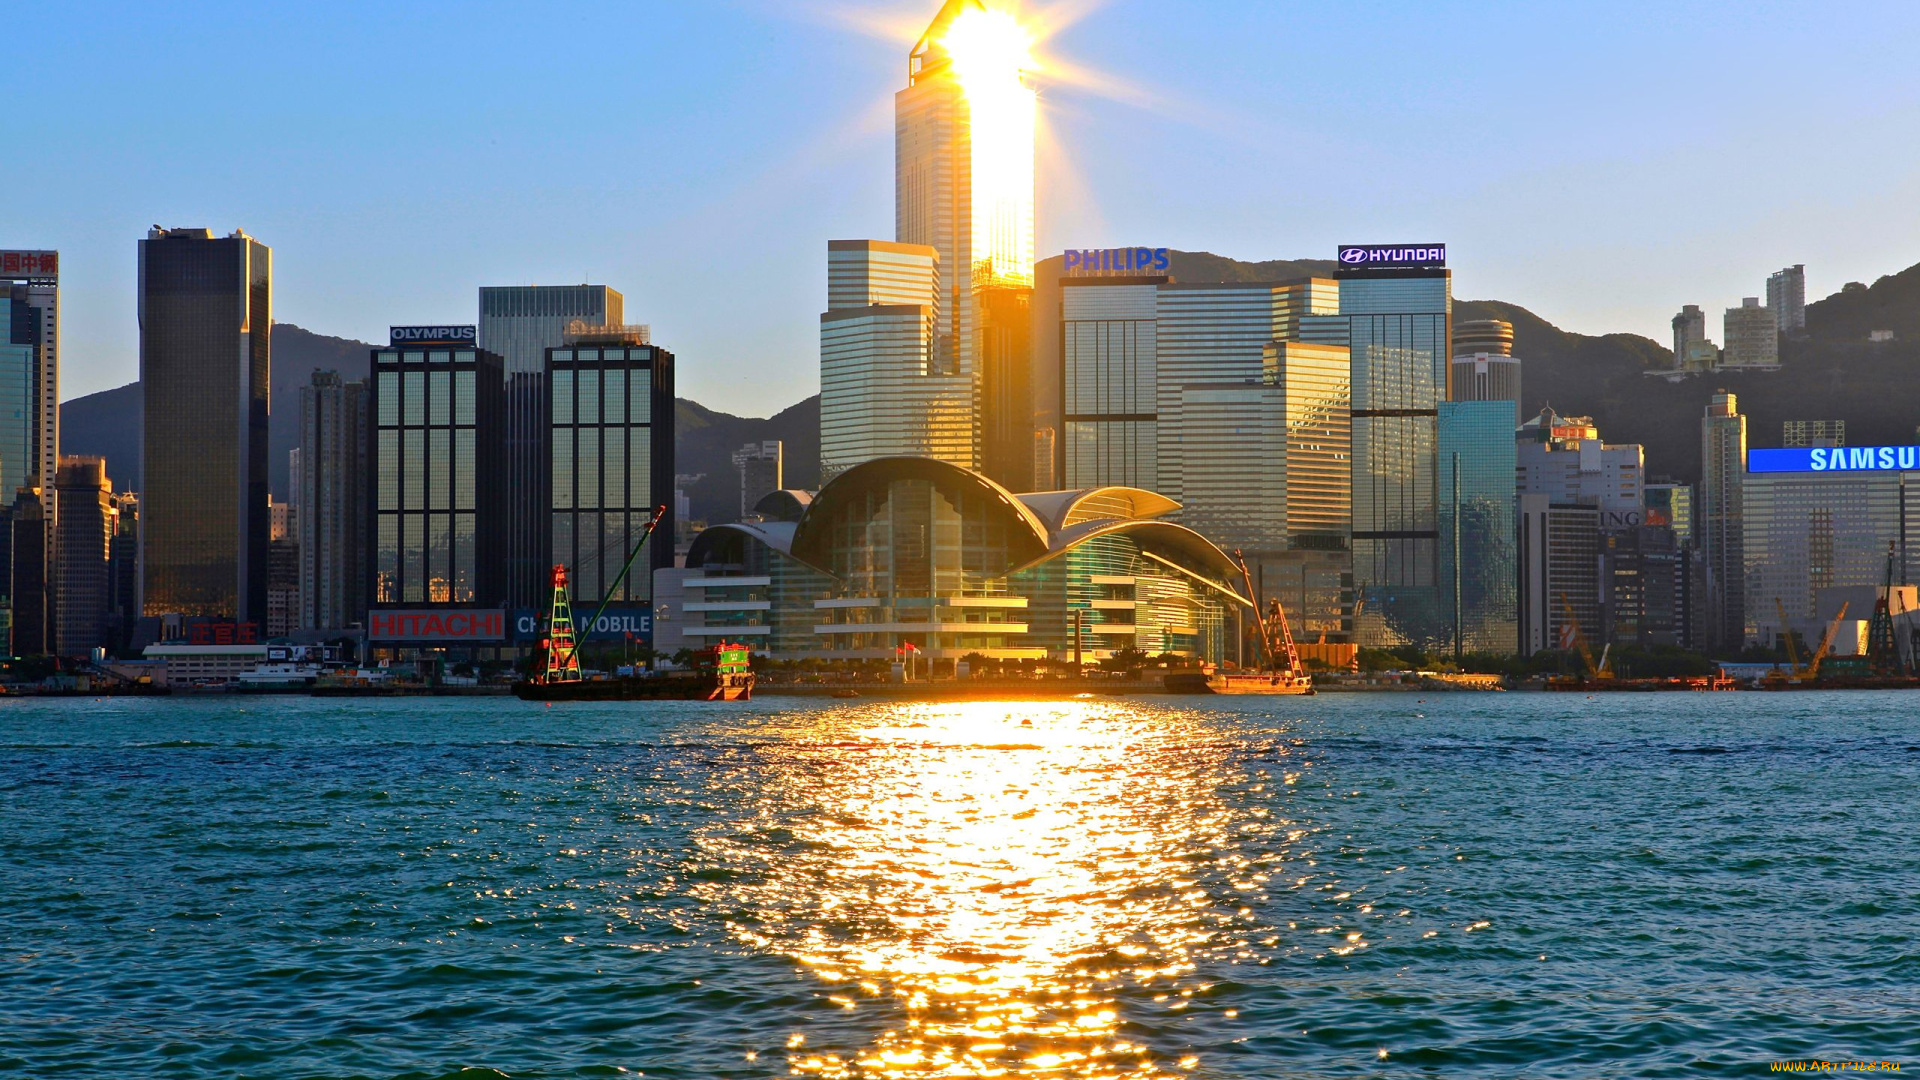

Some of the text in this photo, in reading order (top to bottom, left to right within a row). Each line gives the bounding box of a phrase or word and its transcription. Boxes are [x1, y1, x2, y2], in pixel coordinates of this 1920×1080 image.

[0, 253, 56, 273] 国中钢
[1063, 247, 1169, 271] PHILIPS
[1369, 248, 1444, 261] HYUNDAI
[391, 327, 475, 339] OLYMPUS
[1810, 446, 1920, 471] SAMSU
[1600, 511, 1640, 527] ING
[191, 622, 258, 645] 正官庄
[371, 613, 502, 636] HITACHI
[581, 616, 650, 633] MOBILE
